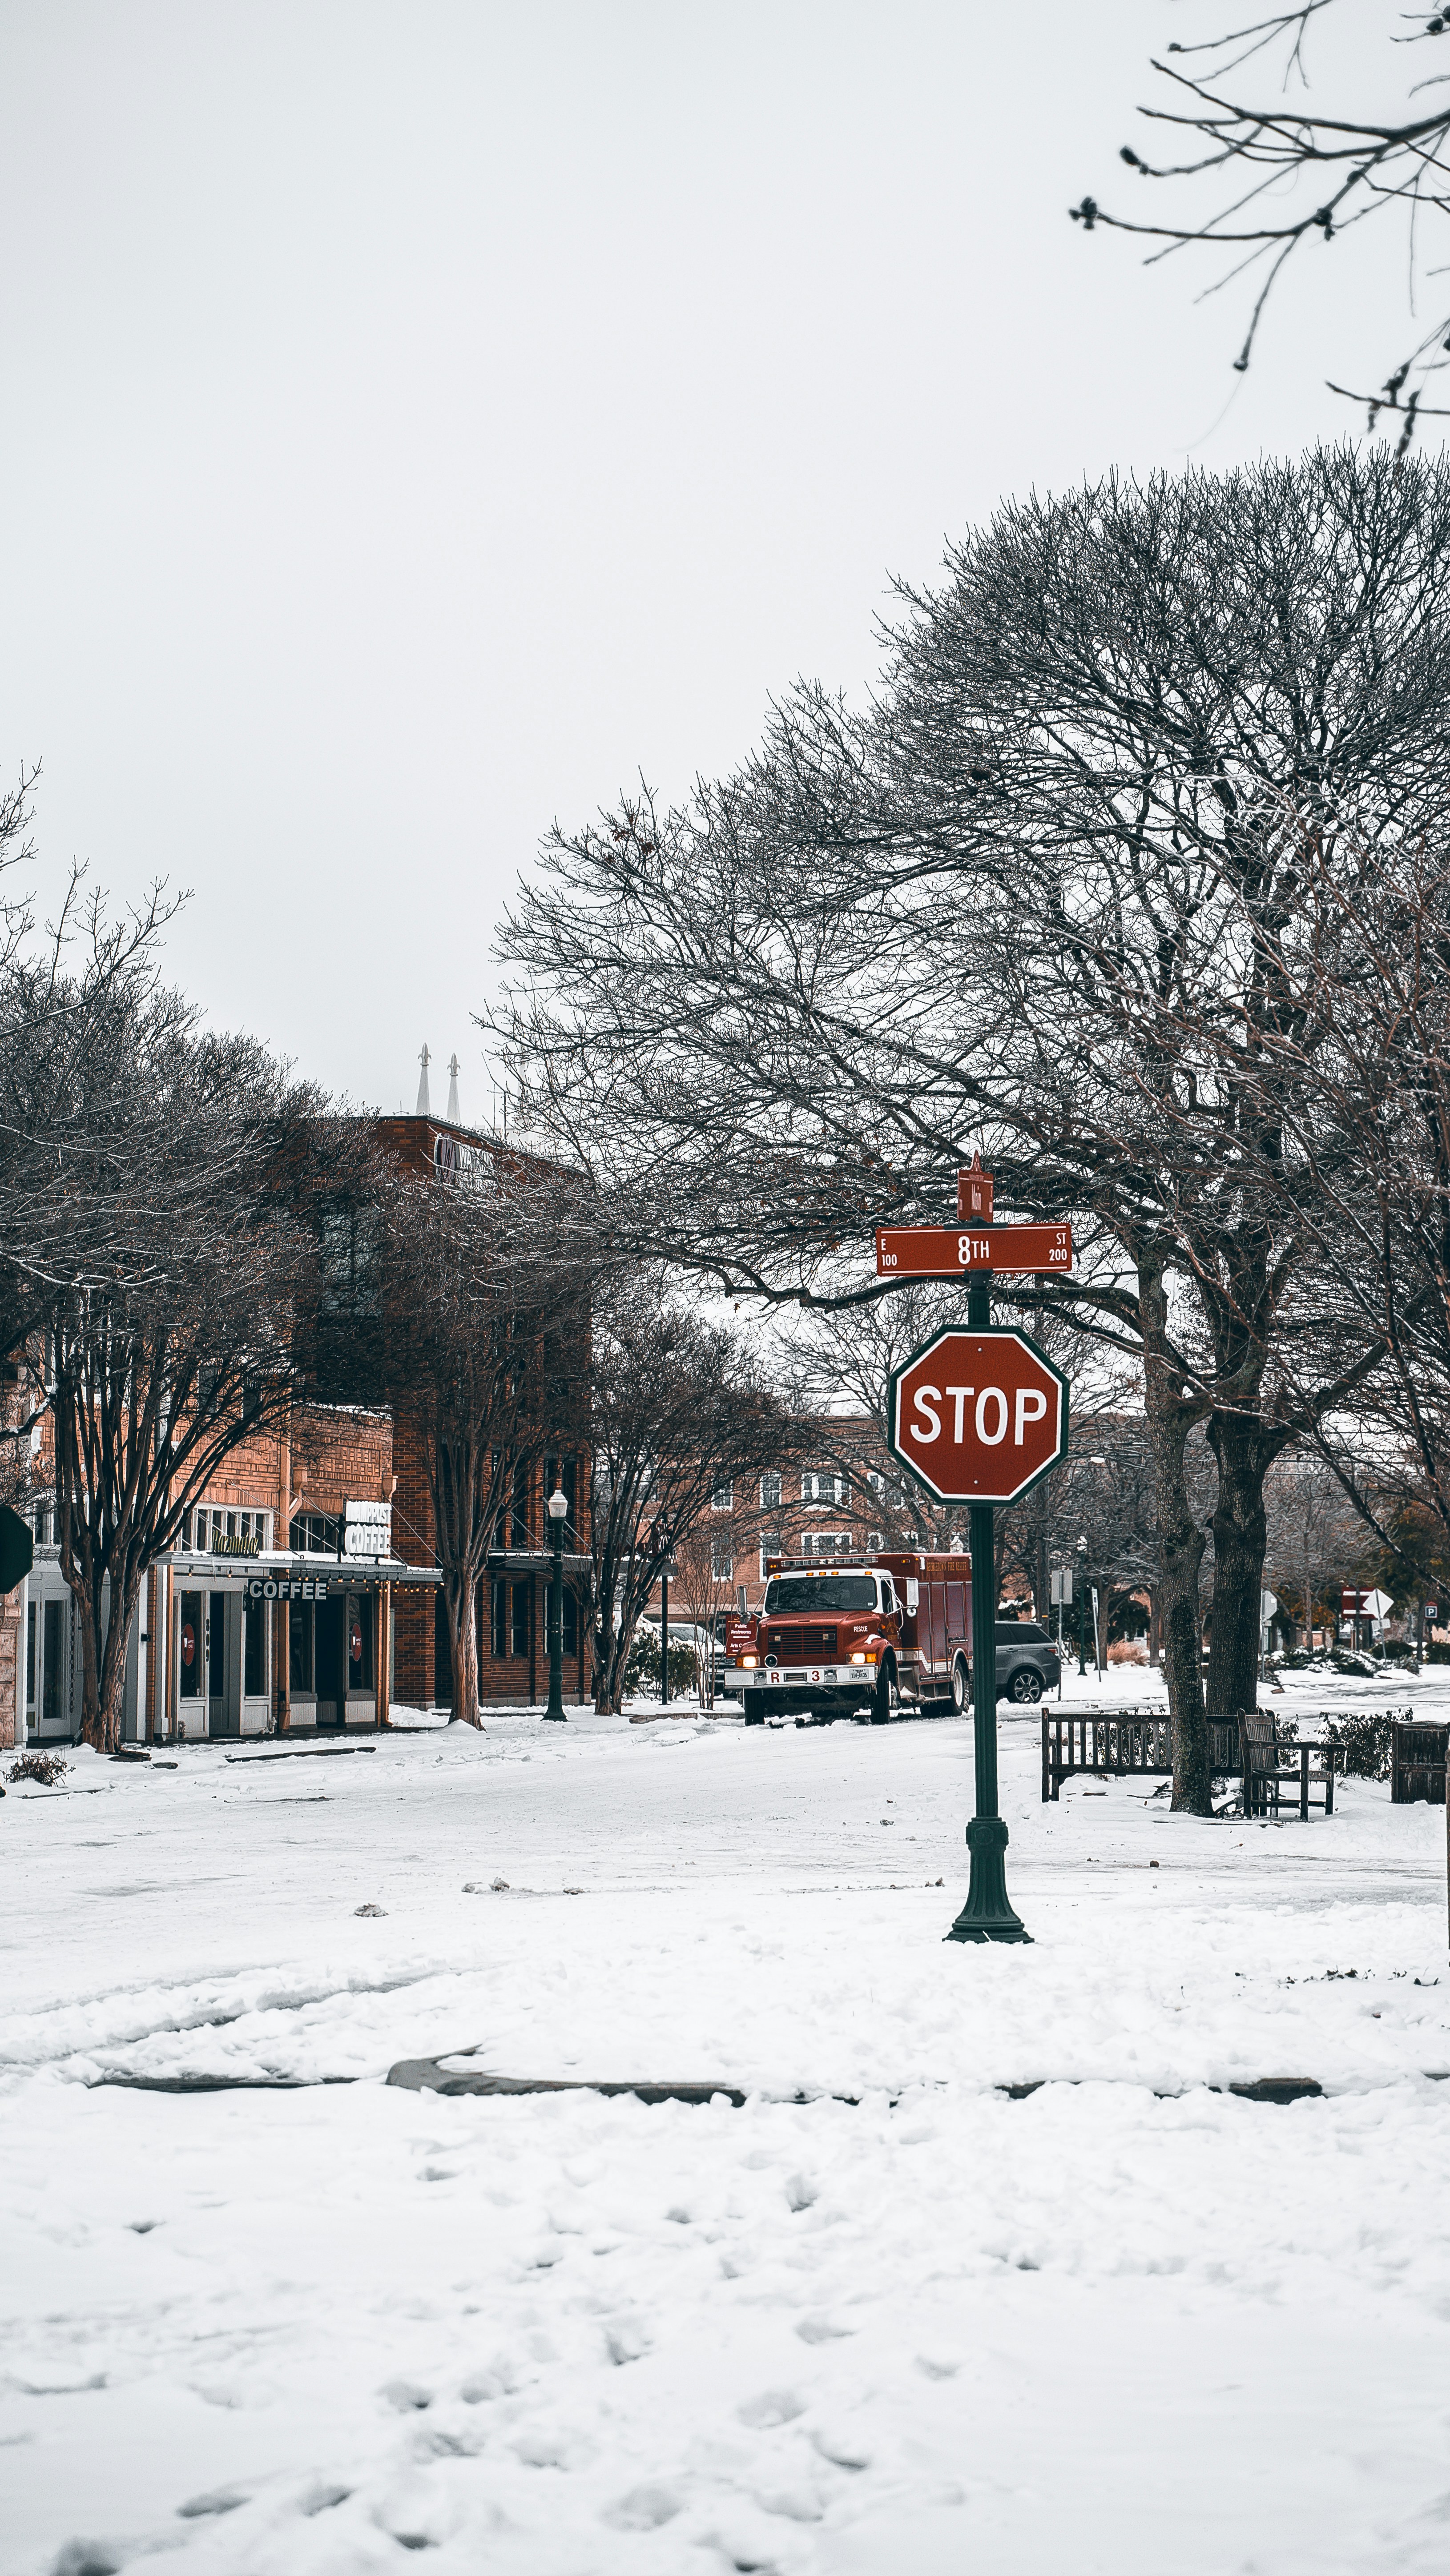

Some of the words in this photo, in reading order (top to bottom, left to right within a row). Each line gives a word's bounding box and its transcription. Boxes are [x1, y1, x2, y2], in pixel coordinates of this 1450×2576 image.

[881, 1238, 886, 1250] E
[958, 1236, 989, 1264] 8TH
[1056, 1233, 1067, 1245] ST
[1049, 1249, 1067, 1261] 200
[881, 1254, 897, 1266] 100
[910, 1385, 1047, 1446] STOP
[345, 1524, 391, 1555] COFFEE
[250, 1581, 326, 1600] COFFEE
[771, 1672, 780, 1683] R
[811, 1670, 820, 1682] 3
